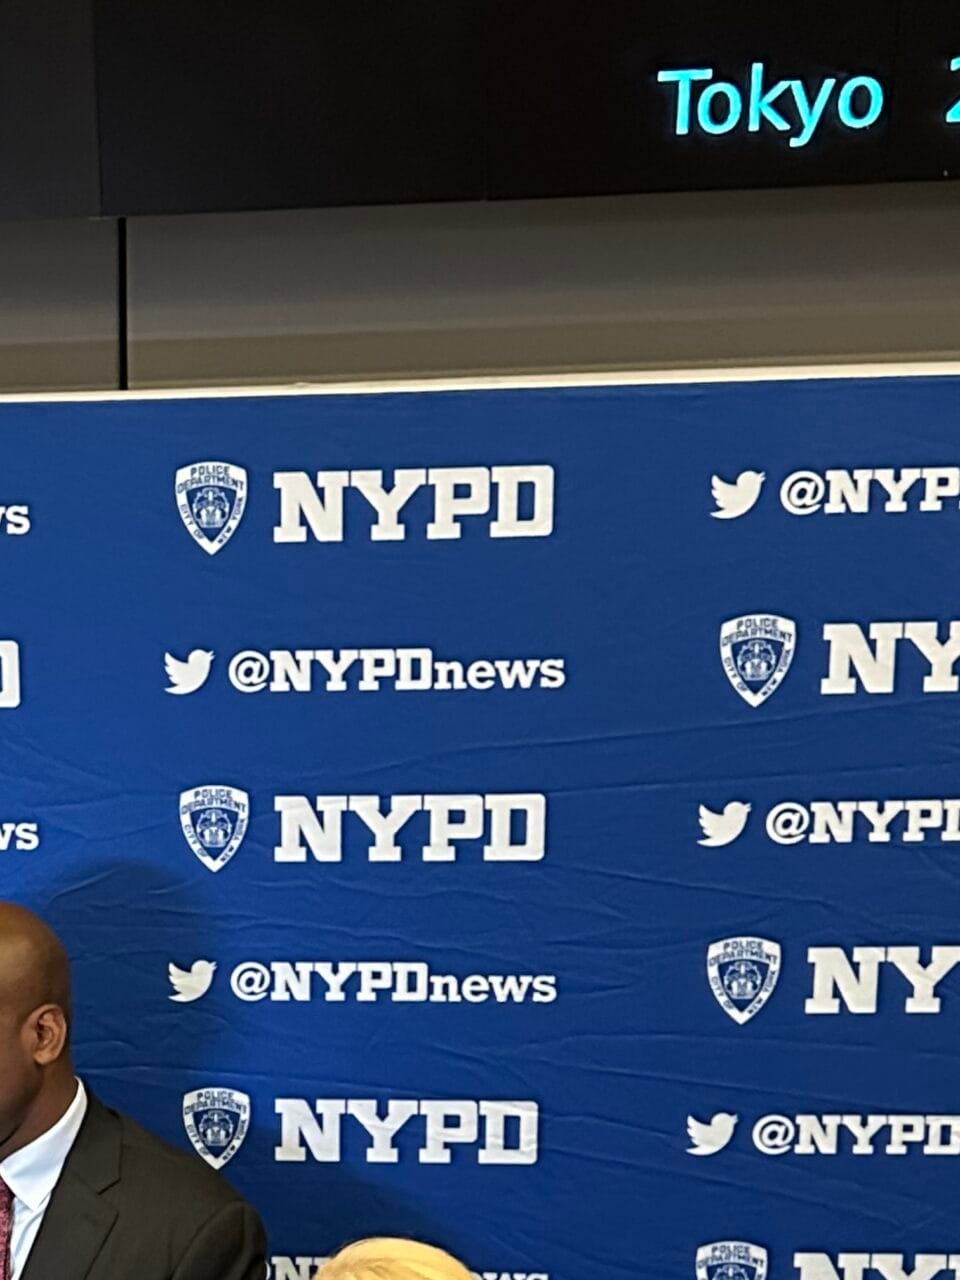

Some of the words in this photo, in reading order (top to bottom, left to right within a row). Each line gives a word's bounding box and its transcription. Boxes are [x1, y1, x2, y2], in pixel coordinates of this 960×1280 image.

[658, 64, 883, 147] Tokyo
[191, 465, 229, 475] POLICE
[274, 465, 554, 543] NYPD
[736, 618, 778, 628] POLICE
[229, 649, 565, 692] @NYPDnews
[821, 621, 960, 694] NY
[275, 794, 545, 862] NYPD
[231, 962, 556, 1002] @NYPDnews
[805, 946, 960, 1013] NY
[275, 1099, 538, 1164] NYPD
[752, 1115, 960, 1154] @NYPD
